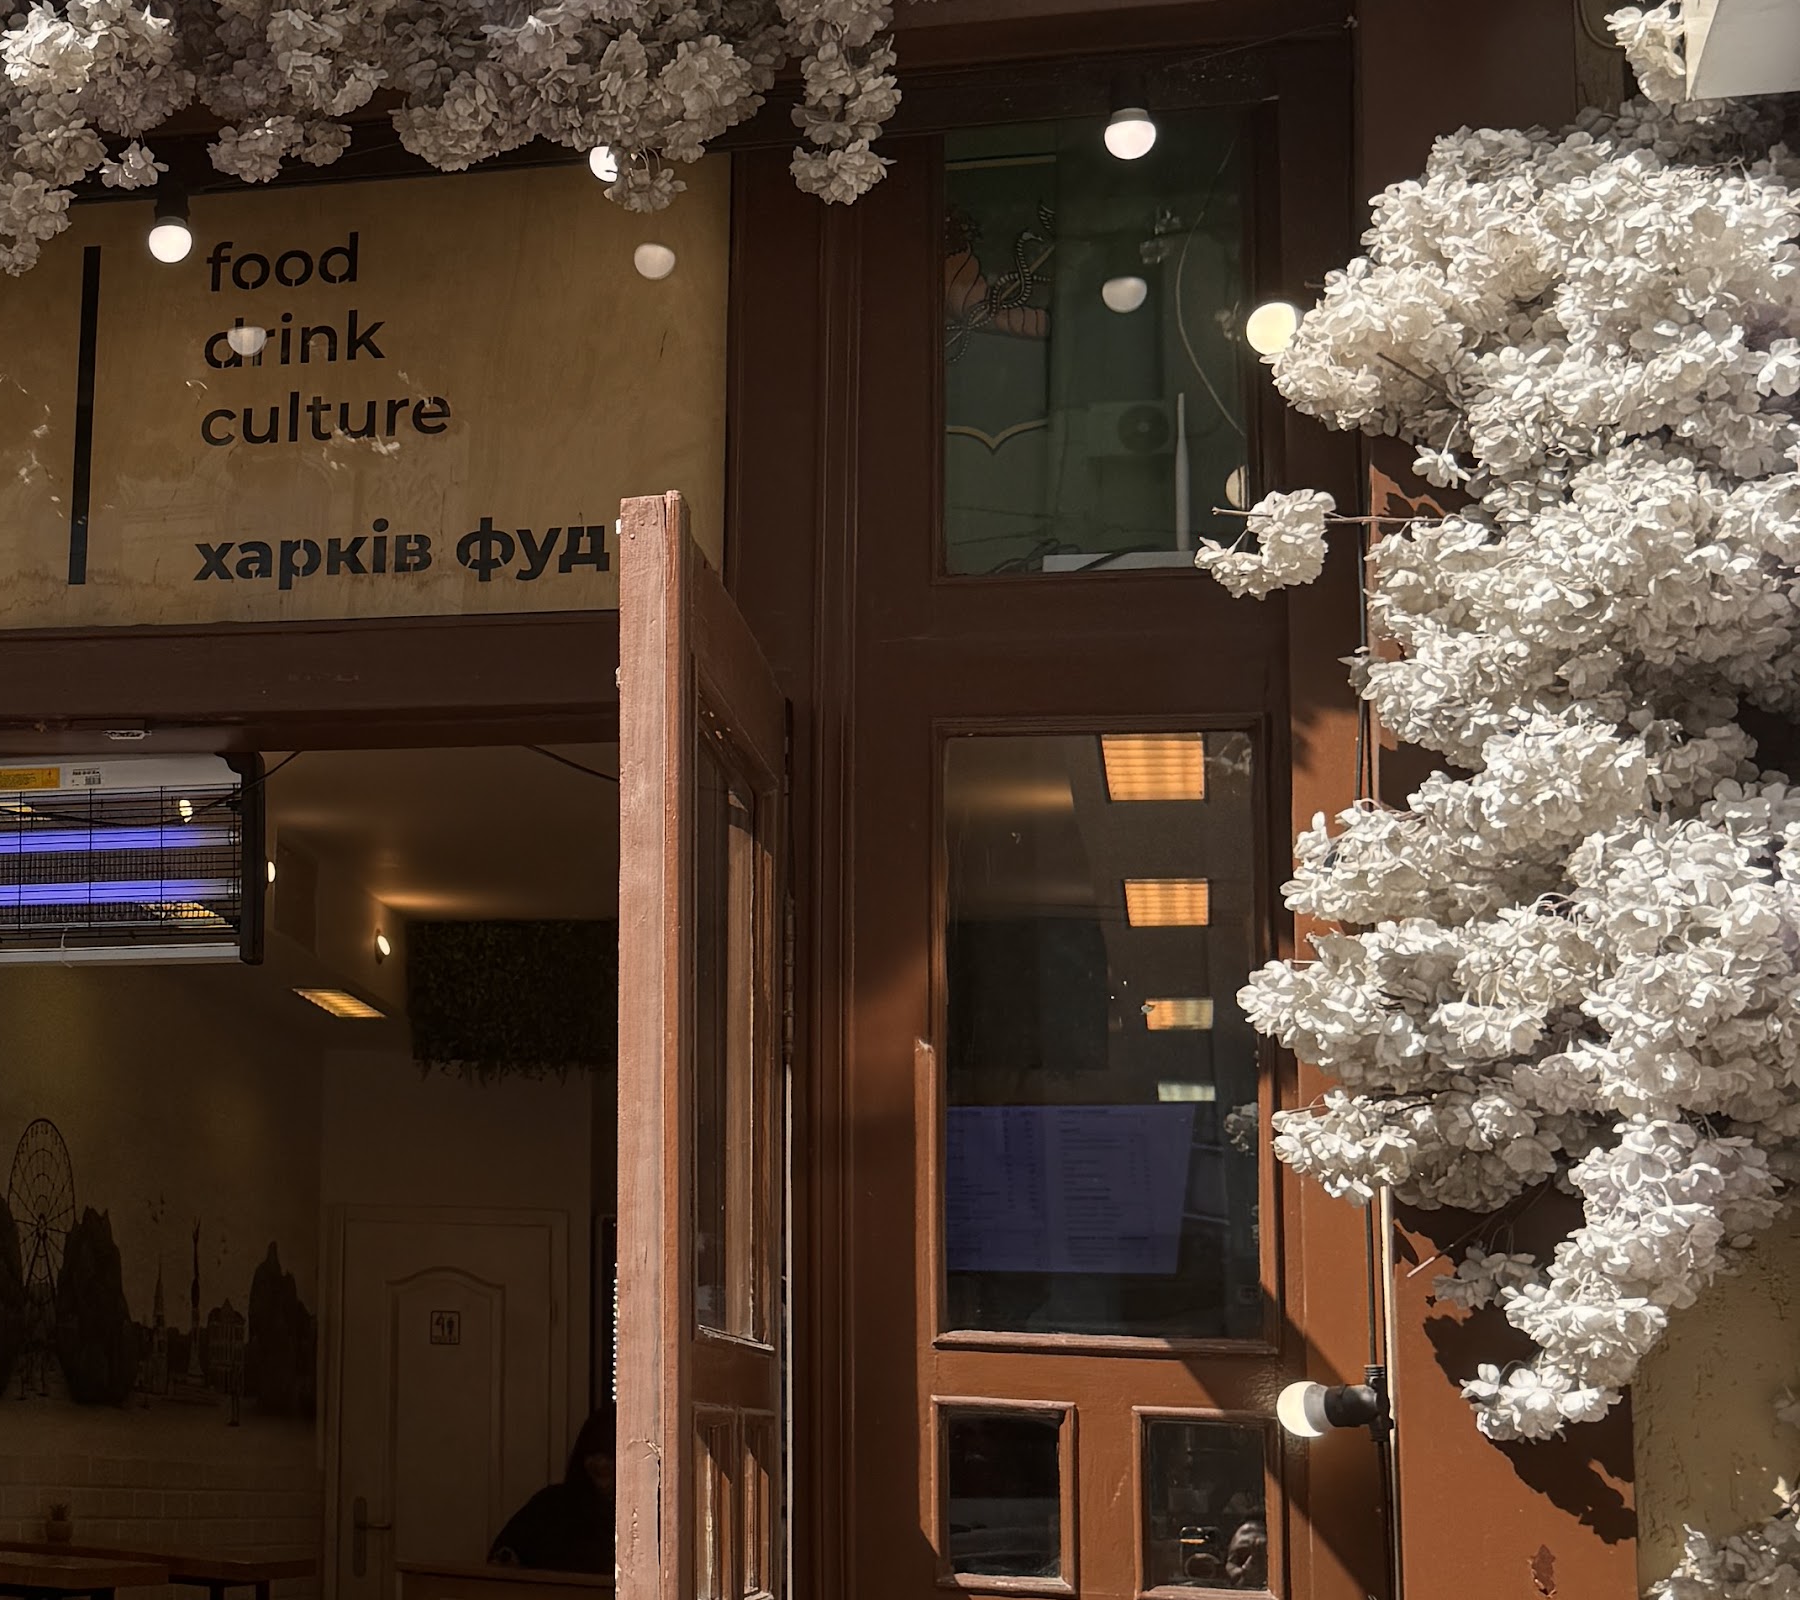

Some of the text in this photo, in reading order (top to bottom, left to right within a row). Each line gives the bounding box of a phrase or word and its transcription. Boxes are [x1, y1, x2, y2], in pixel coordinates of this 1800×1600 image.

[206, 231, 359, 292] food
[204, 309, 386, 369] drink
[201, 391, 451, 446] culture
[193, 516, 611, 590] харків фуд
